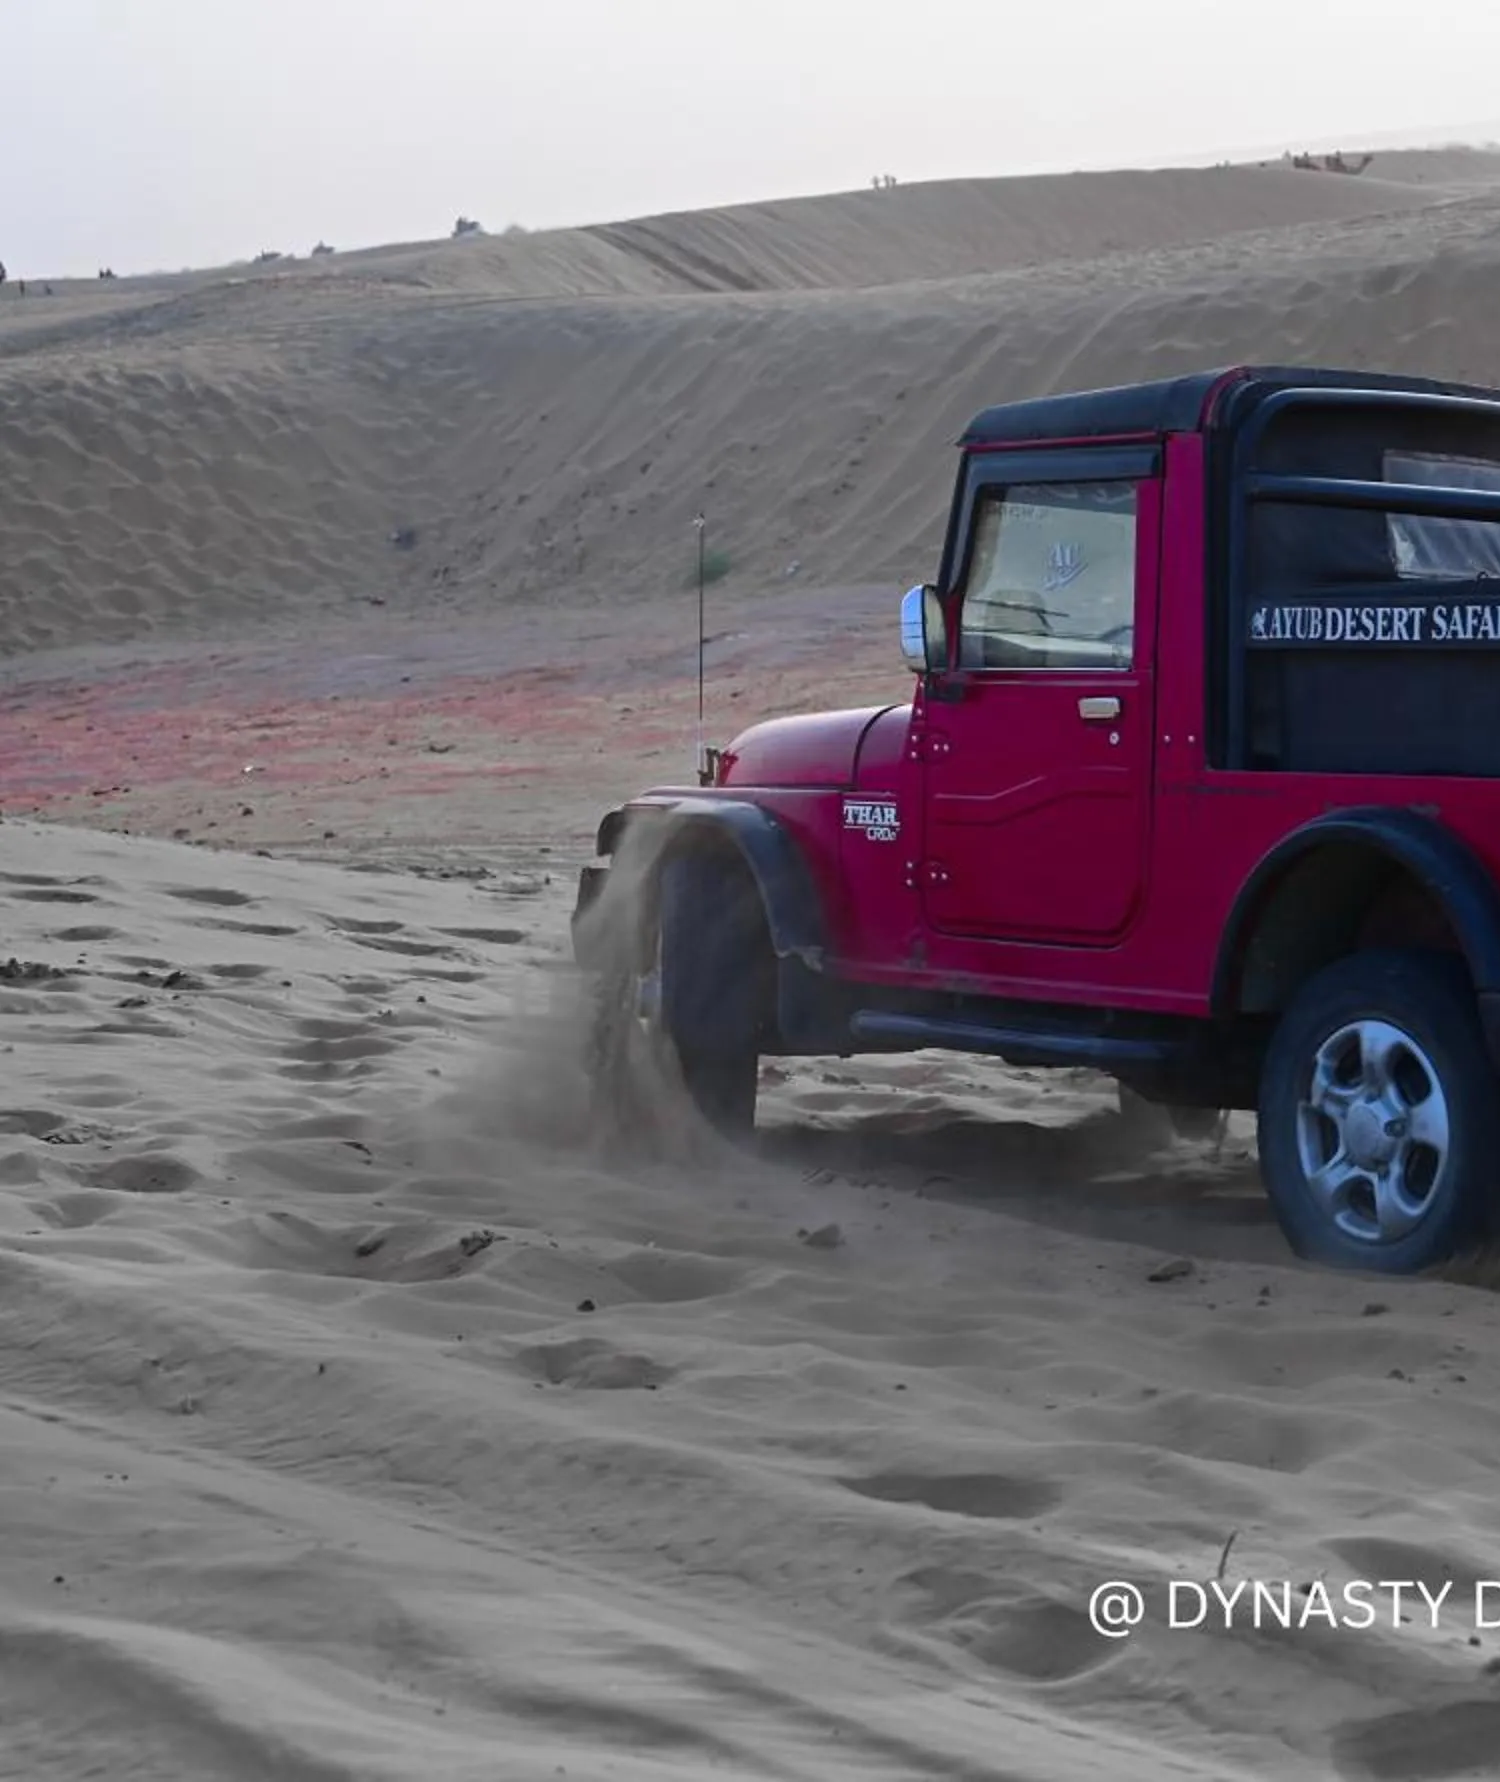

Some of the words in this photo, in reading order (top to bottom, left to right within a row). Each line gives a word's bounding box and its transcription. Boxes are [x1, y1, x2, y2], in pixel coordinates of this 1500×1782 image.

[1269, 606, 1322, 639] AYUB
[1324, 606, 1424, 641] DESERT
[843, 805, 901, 826] THAR
